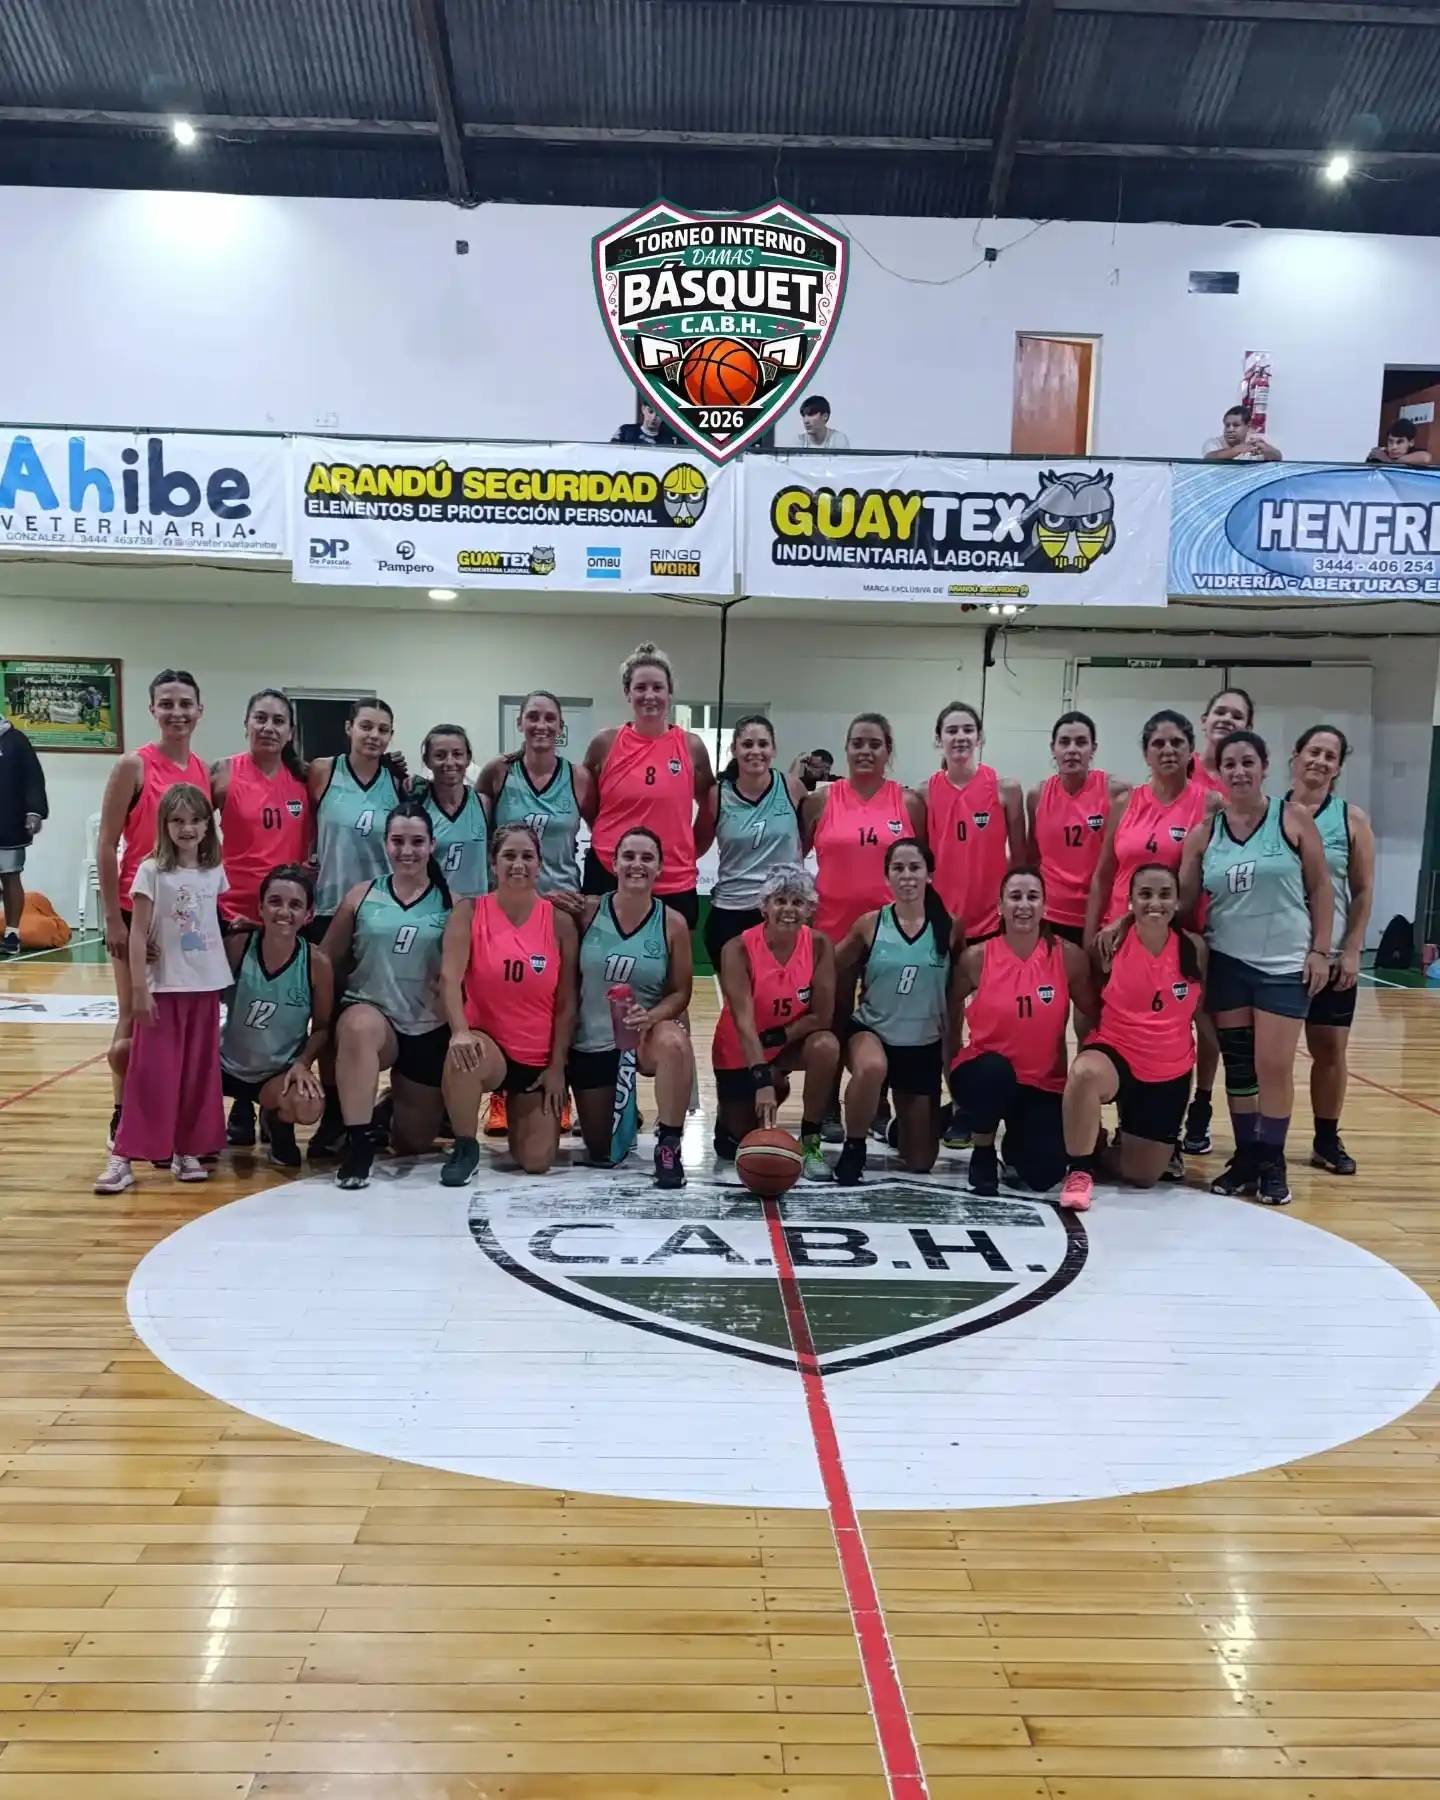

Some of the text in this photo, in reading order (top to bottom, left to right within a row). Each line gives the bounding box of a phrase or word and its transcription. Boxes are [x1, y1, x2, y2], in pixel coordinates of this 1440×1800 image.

[0, 435, 252, 520] Ahibe
[307, 461, 658, 503] ARANDÚ SEGURIDAD
[308, 499, 658, 524] ELEMENTOS DE PROTECCIÓN PERSONAL
[775, 491, 1025, 544] GUAYTEX
[310, 538, 350, 558] DP
[458, 551, 530, 567] GUAYTEX
[650, 549, 701, 561] RINGO
[776, 544, 1025, 568] INDUMENTARIA LABORAL
[378, 560, 434, 575] Pampero
[653, 562, 698, 575] WORK
[1315, 559, 1353, 571] 3444
[1368, 560, 1399, 573] 406
[1403, 560, 1434, 573] 254
[863, 584, 944, 594] MARCA EXCLUSIVA DE
[1195, 573, 1284, 589] VIDRERÍA
[1300, 577, 1419, 592] ABERTURAS
[1425, 579, 1440, 592] E
[645, 767, 655, 786] 8
[263, 807, 282, 830] 01
[353, 809, 374, 837] 4
[751, 819, 768, 849] 7
[858, 827, 879, 847] 14
[957, 820, 967, 842] 0
[1063, 825, 1083, 847] 12
[1145, 832, 1158, 853] 4
[445, 841, 465, 872] 5
[1225, 860, 1257, 895] 13
[393, 926, 418, 955] 9
[503, 959, 524, 983] 10
[604, 953, 637, 983] 10
[895, 965, 919, 995] 8
[772, 998, 792, 1017] 15
[1016, 995, 1033, 1018] 11
[1151, 990, 1164, 1013] 6
[244, 998, 279, 1030] 12
[526, 1222, 1049, 1274] C.A.B.H.
